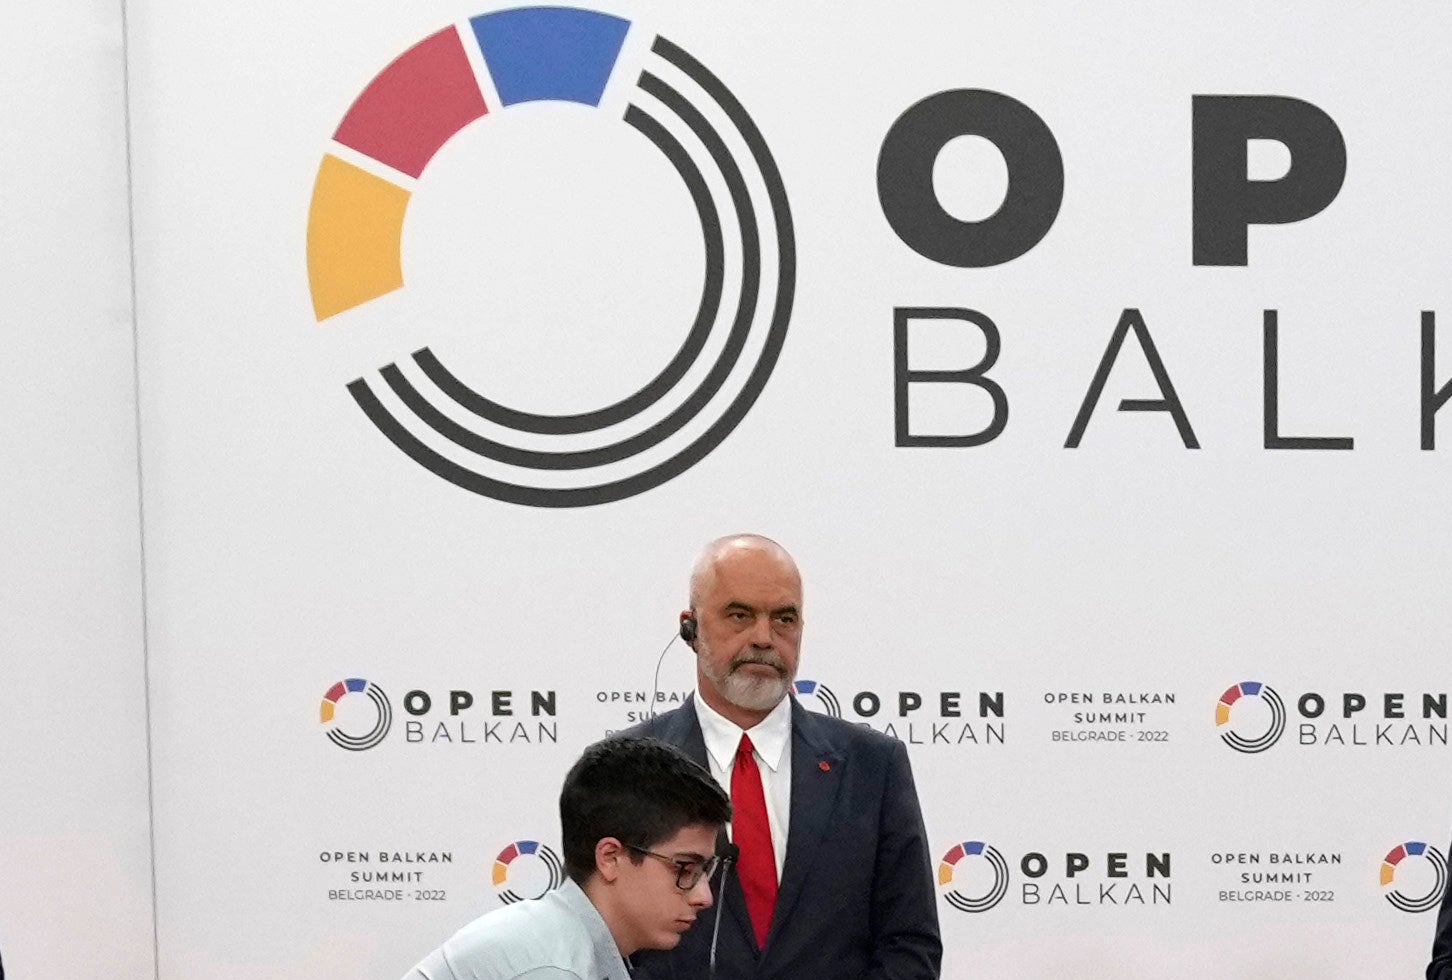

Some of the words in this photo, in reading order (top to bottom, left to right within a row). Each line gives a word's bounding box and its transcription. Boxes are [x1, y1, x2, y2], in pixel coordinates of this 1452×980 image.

[403, 689, 557, 717] OPEN
[596, 691, 646, 703] OPEN
[1044, 692, 1093, 704] OPEN
[1102, 692, 1175, 704] BALKAN
[853, 691, 1004, 718] OPEN
[1297, 692, 1448, 719] OPEN
[1074, 712, 1146, 724] SUMMIT
[405, 720, 557, 744] BALKAN
[858, 722, 1004, 745] ALKAN
[1051, 730, 1127, 742] BELGRADE
[1137, 730, 1169, 742] 2022
[1299, 723, 1448, 746] BALKAN
[319, 851, 369, 863] OPEN
[379, 851, 452, 863] BALKAN
[1211, 853, 1260, 865] OPEN
[1269, 853, 1341, 865] BALKAN
[1020, 852, 1171, 879] OPEN
[350, 871, 423, 883] SUMMIT
[1241, 872, 1313, 884] SUMMIT
[328, 889, 403, 901] BELGRADE
[414, 889, 446, 901] 2022
[1022, 882, 1171, 905] BALKAN
[1218, 890, 1292, 902] BELGRADE
[1303, 890, 1335, 902] 2022
